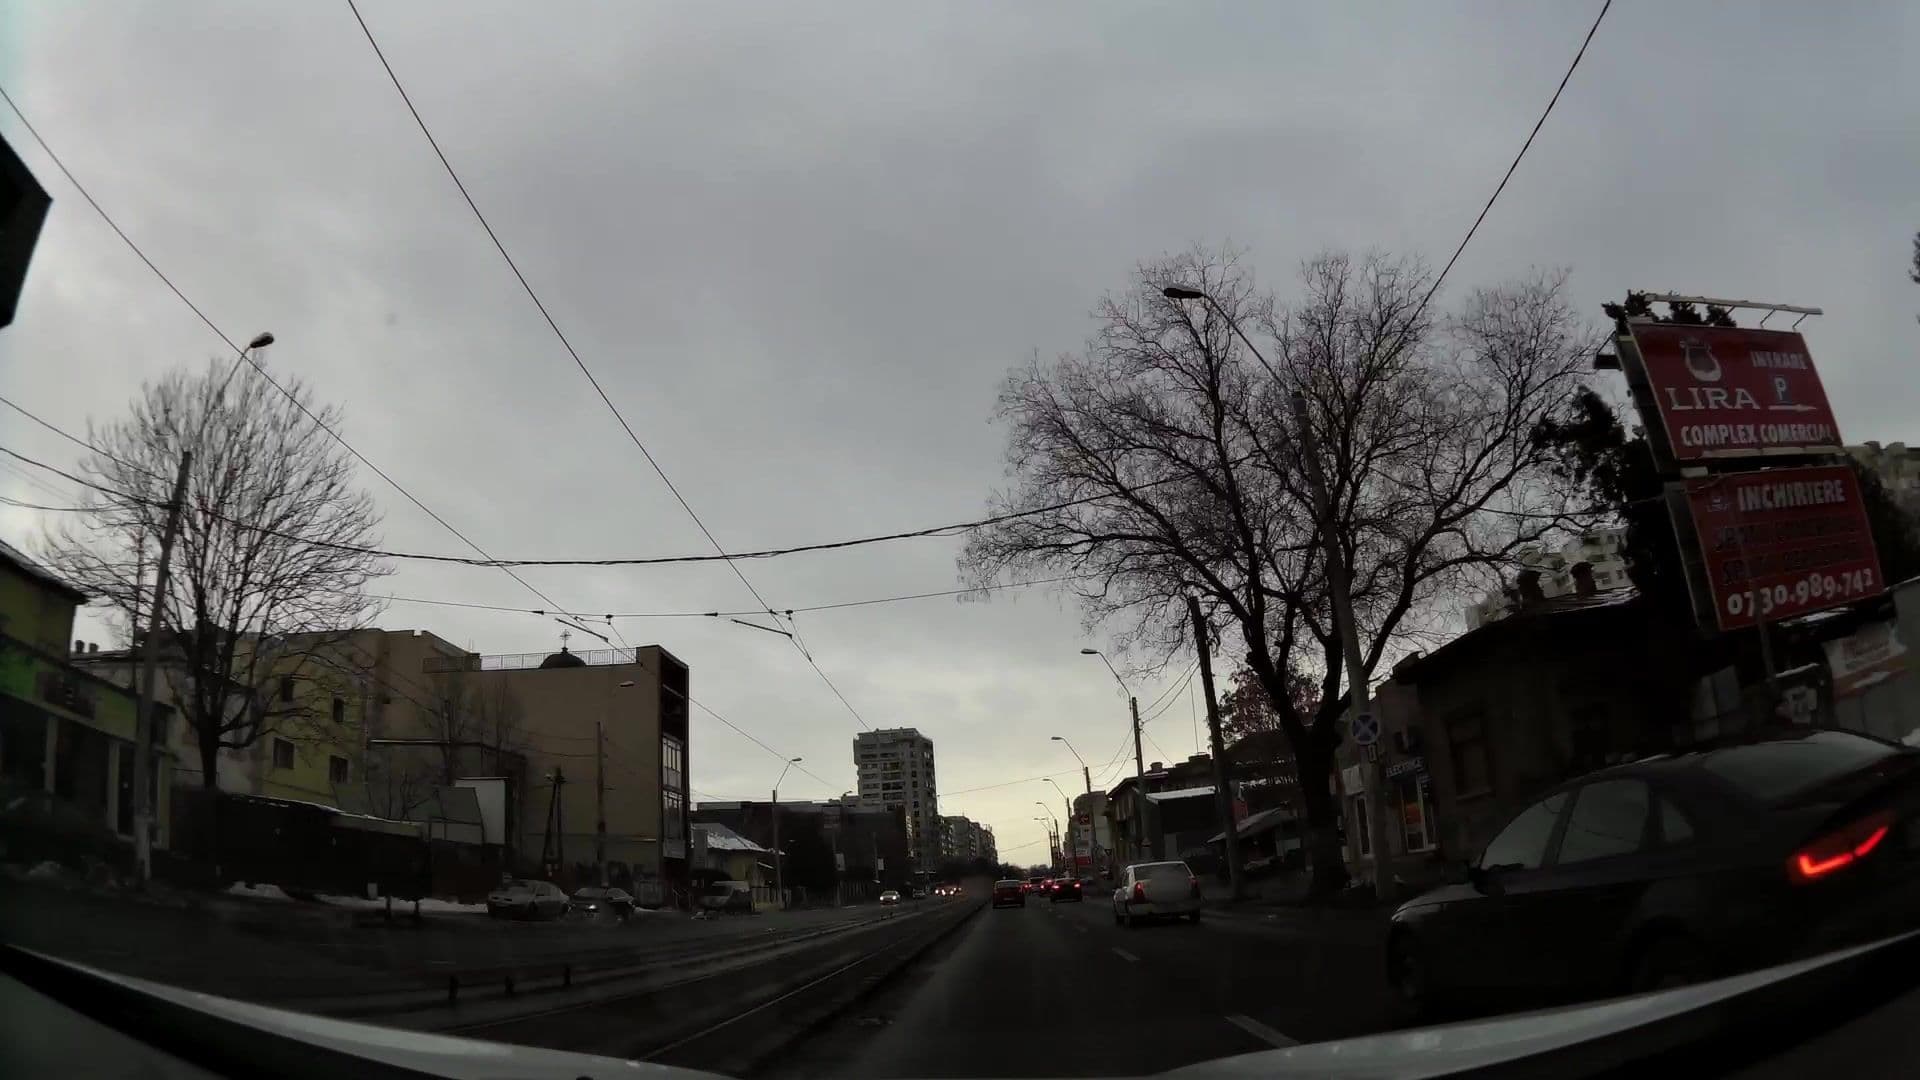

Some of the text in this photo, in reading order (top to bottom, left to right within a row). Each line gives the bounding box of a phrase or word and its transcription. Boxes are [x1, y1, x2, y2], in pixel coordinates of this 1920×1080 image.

[1665, 387, 1760, 410] LIRA
[1774, 377, 1787, 400] P
[1681, 424, 1835, 446] COMPLEX COMERCIAL
[1738, 480, 1846, 511] INCHIRIERE
